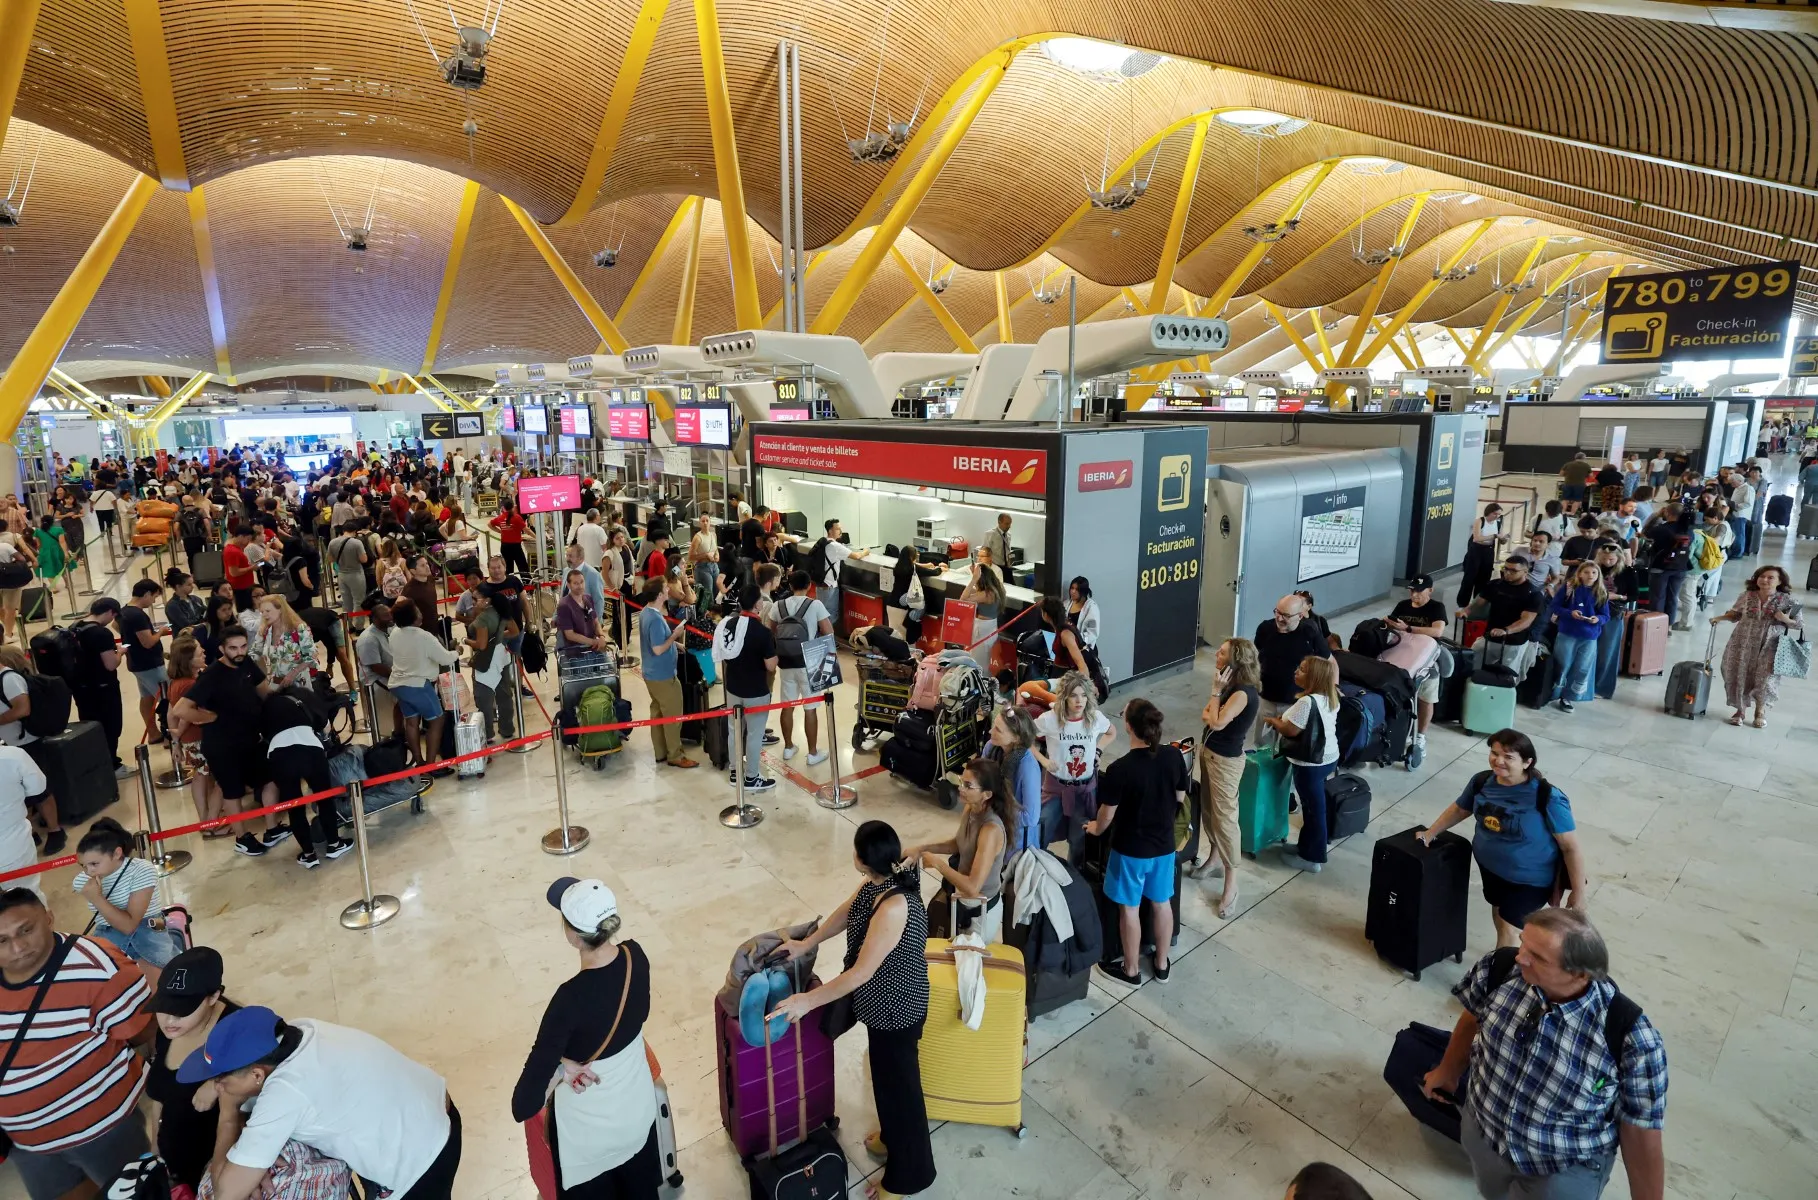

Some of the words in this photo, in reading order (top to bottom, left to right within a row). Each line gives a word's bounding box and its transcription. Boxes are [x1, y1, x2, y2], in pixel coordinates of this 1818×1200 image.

[1690, 276, 1704, 288] to
[1706, 268, 1791, 301] 799
[1612, 278, 1686, 309] 780
[1688, 292, 1699, 302] a
[1696, 317, 1757, 331] Check-in
[1669, 330, 1781, 347] Facturación
[680, 388, 692, 400] 812
[707, 386, 720, 400] 811
[778, 383, 797, 399] 810
[760, 440, 780, 450] Atención
[781, 442, 786, 451] al
[787, 443, 804, 452] cliente
[805, 446, 809, 454] y
[810, 445, 826, 454] venta
[826, 445, 834, 454] de
[834, 446, 859, 456] billetes
[760, 453, 781, 462] Customer
[781, 456, 798, 465] service
[809, 458, 825, 467] ticket
[825, 459, 837, 468] sale
[953, 456, 1012, 474] IBERIA
[1084, 471, 1115, 482] IBERIA
[1336, 492, 1348, 505] info
[1427, 505, 1439, 520] 790
[1440, 502, 1453, 517] 799
[1159, 522, 1186, 537] Check-in
[1147, 535, 1195, 555] Facturación
[1140, 565, 1167, 590] 810
[1173, 559, 1198, 582] 819
[848, 610, 869, 622] IBERIA
[166, 969, 187, 989] A
